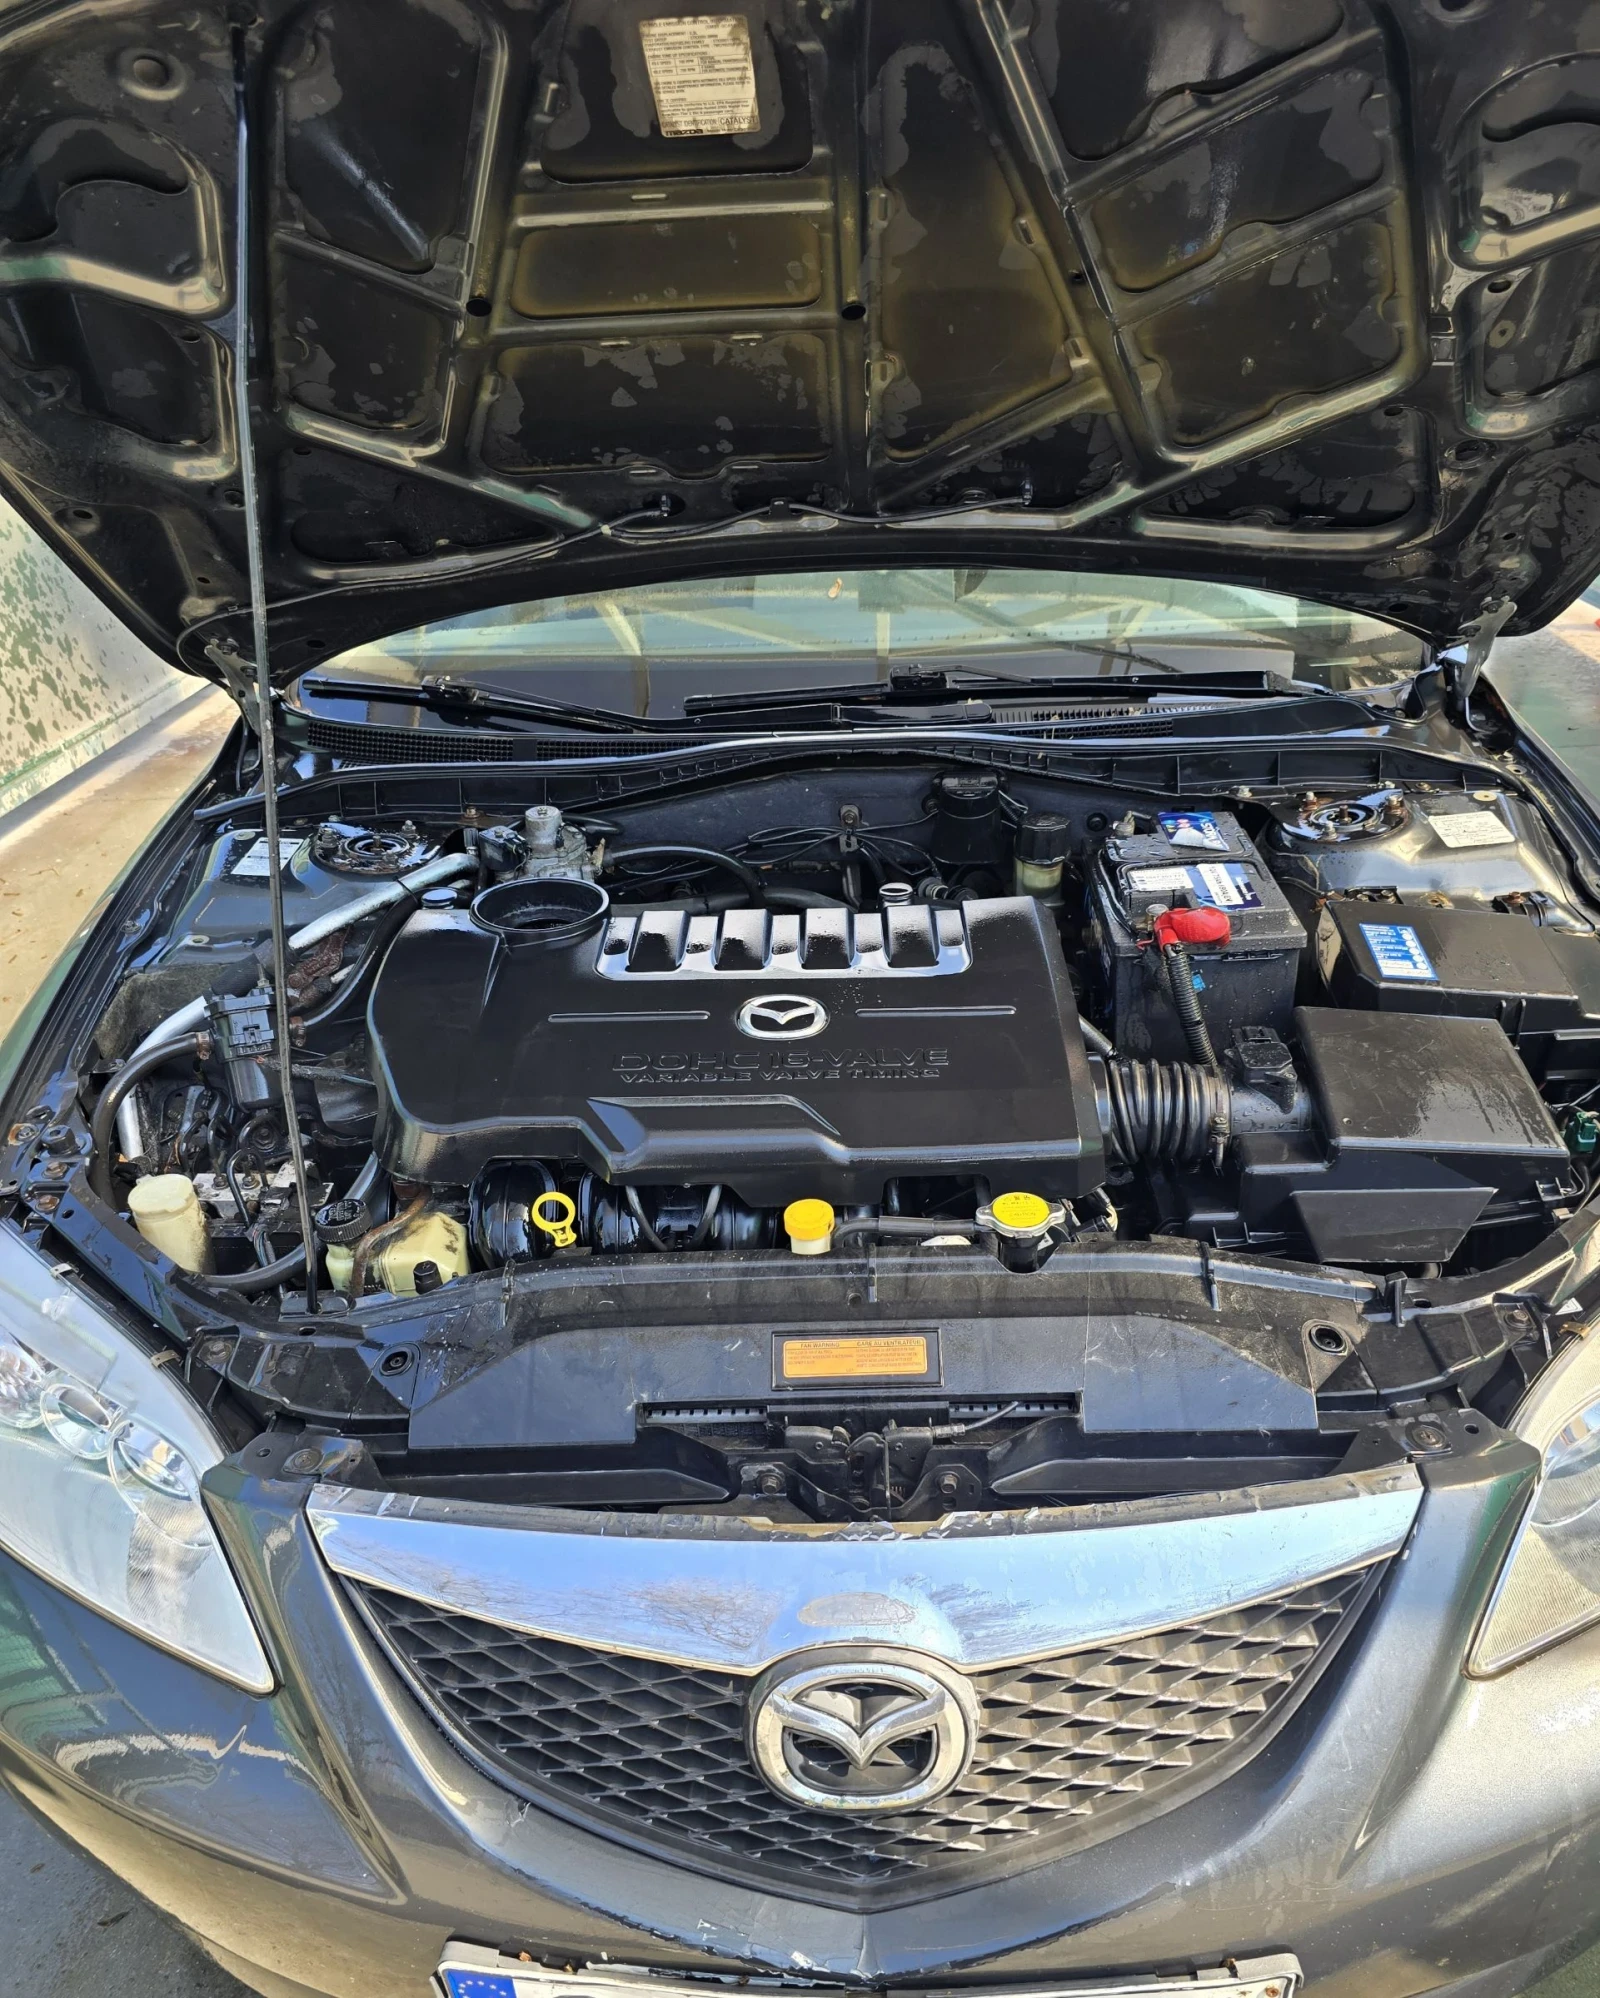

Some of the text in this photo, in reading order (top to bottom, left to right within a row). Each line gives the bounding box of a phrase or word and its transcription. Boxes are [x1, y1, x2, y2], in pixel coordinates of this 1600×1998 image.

[612, 1047, 949, 1071] DOHC 16-VALVE
[620, 1068, 940, 1083] VARIABLE VALVE TIMING
